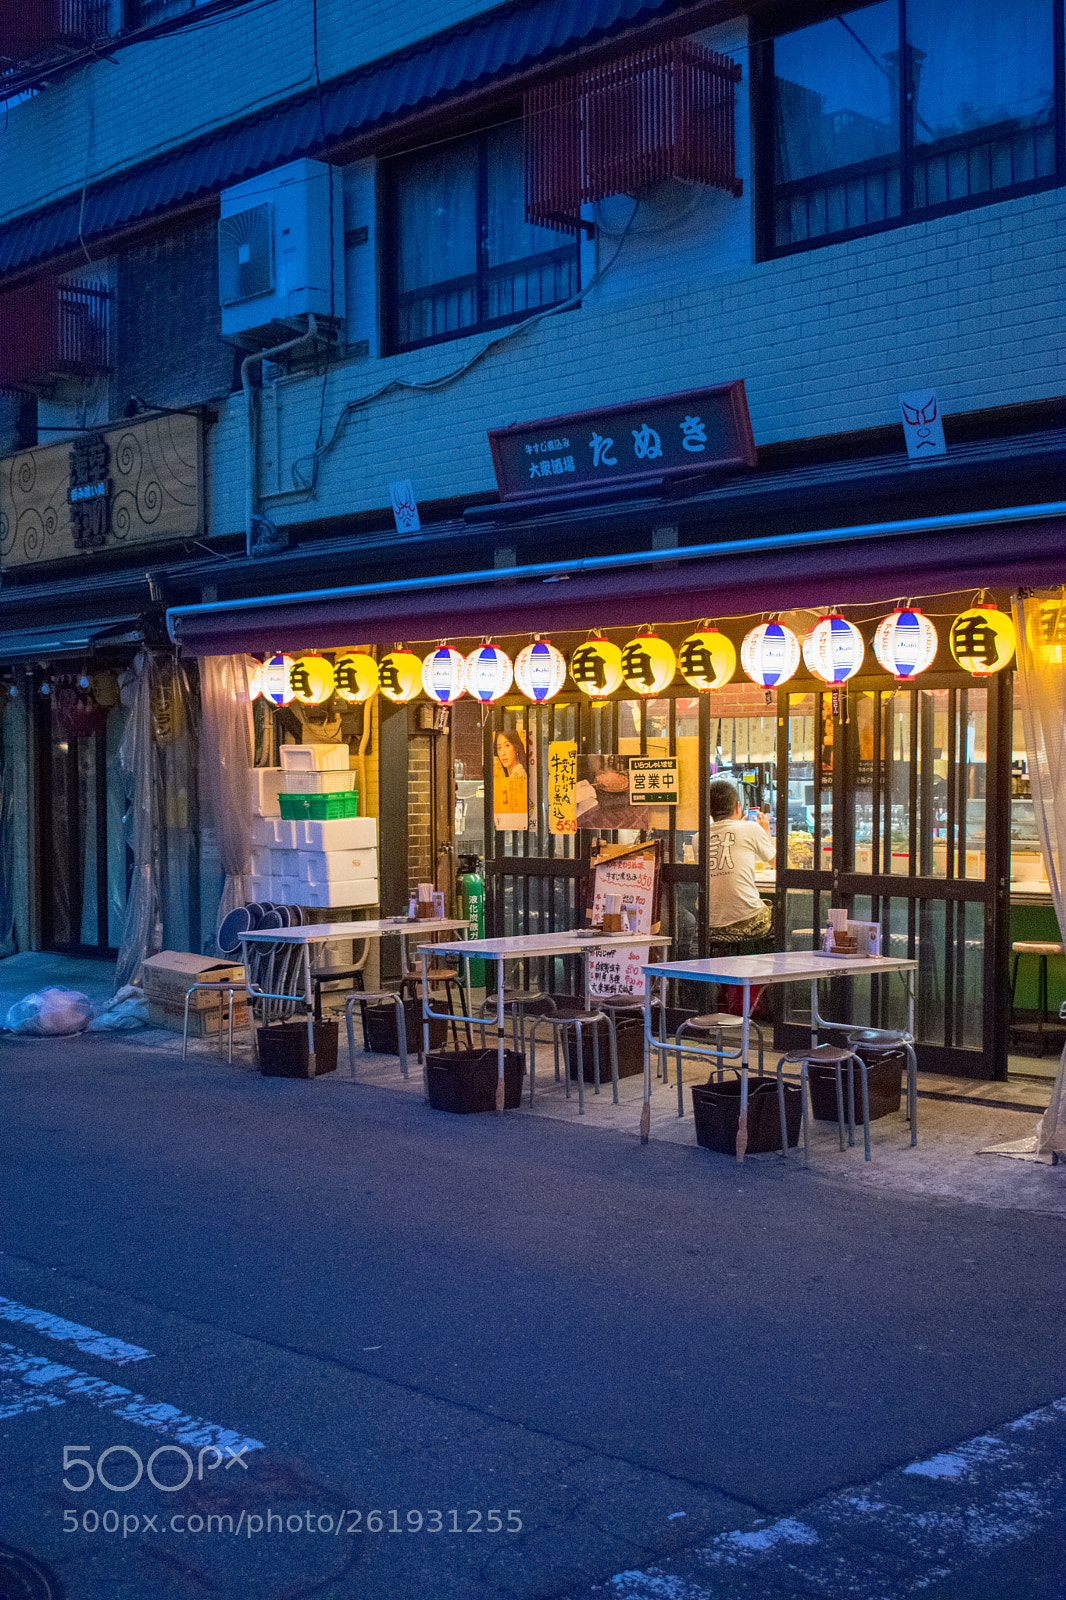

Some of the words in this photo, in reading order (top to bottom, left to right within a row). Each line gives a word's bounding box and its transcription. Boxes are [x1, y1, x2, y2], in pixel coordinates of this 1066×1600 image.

[589, 416, 708, 467] たぬき
[529, 455, 576, 479] 大衆酒場
[634, 761, 673, 769] いらっしゃいませ
[634, 773, 674, 789] 営業中
[556, 820, 577, 832] 550
